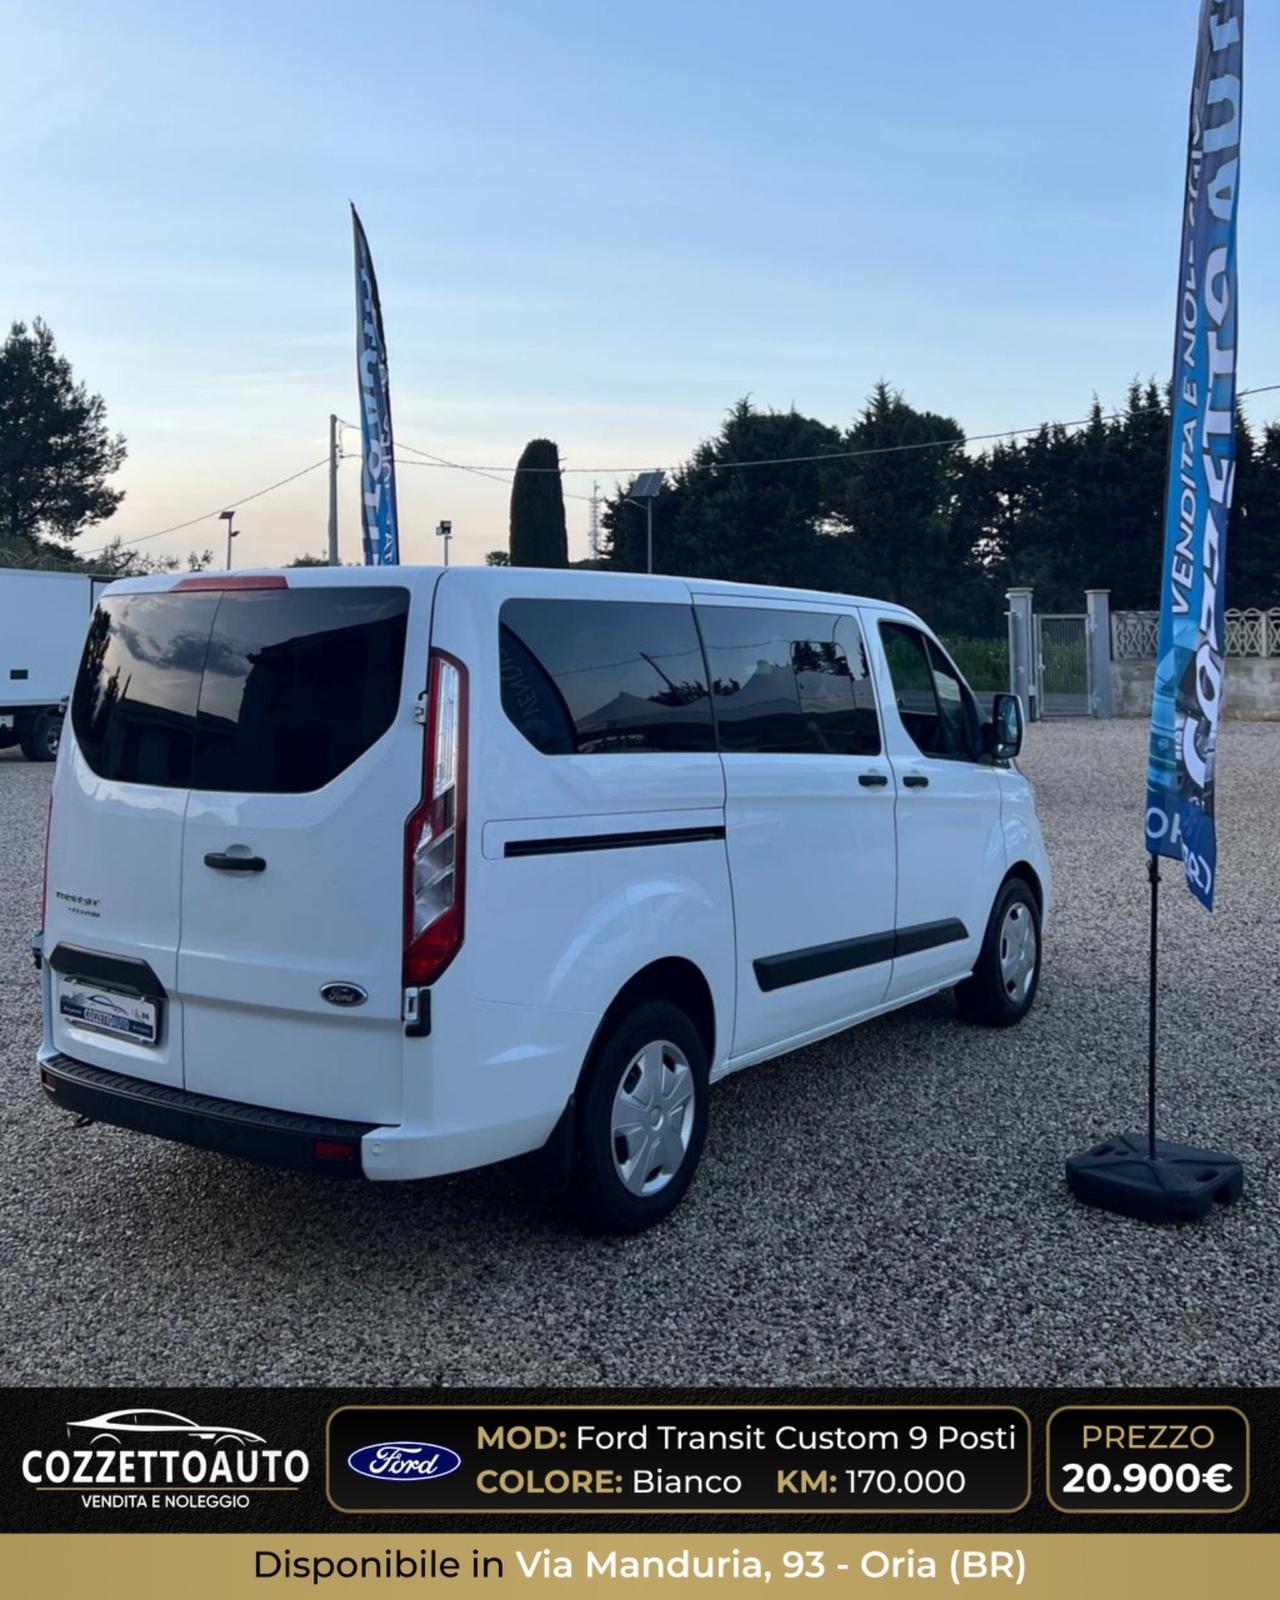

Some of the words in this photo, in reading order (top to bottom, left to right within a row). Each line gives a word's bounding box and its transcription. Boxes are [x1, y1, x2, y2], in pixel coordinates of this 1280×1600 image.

[1182, 382, 1198, 407] E
[1183, 0, 1241, 788] COZZETTOAUT
[1172, 419, 1198, 614] VENDITA
